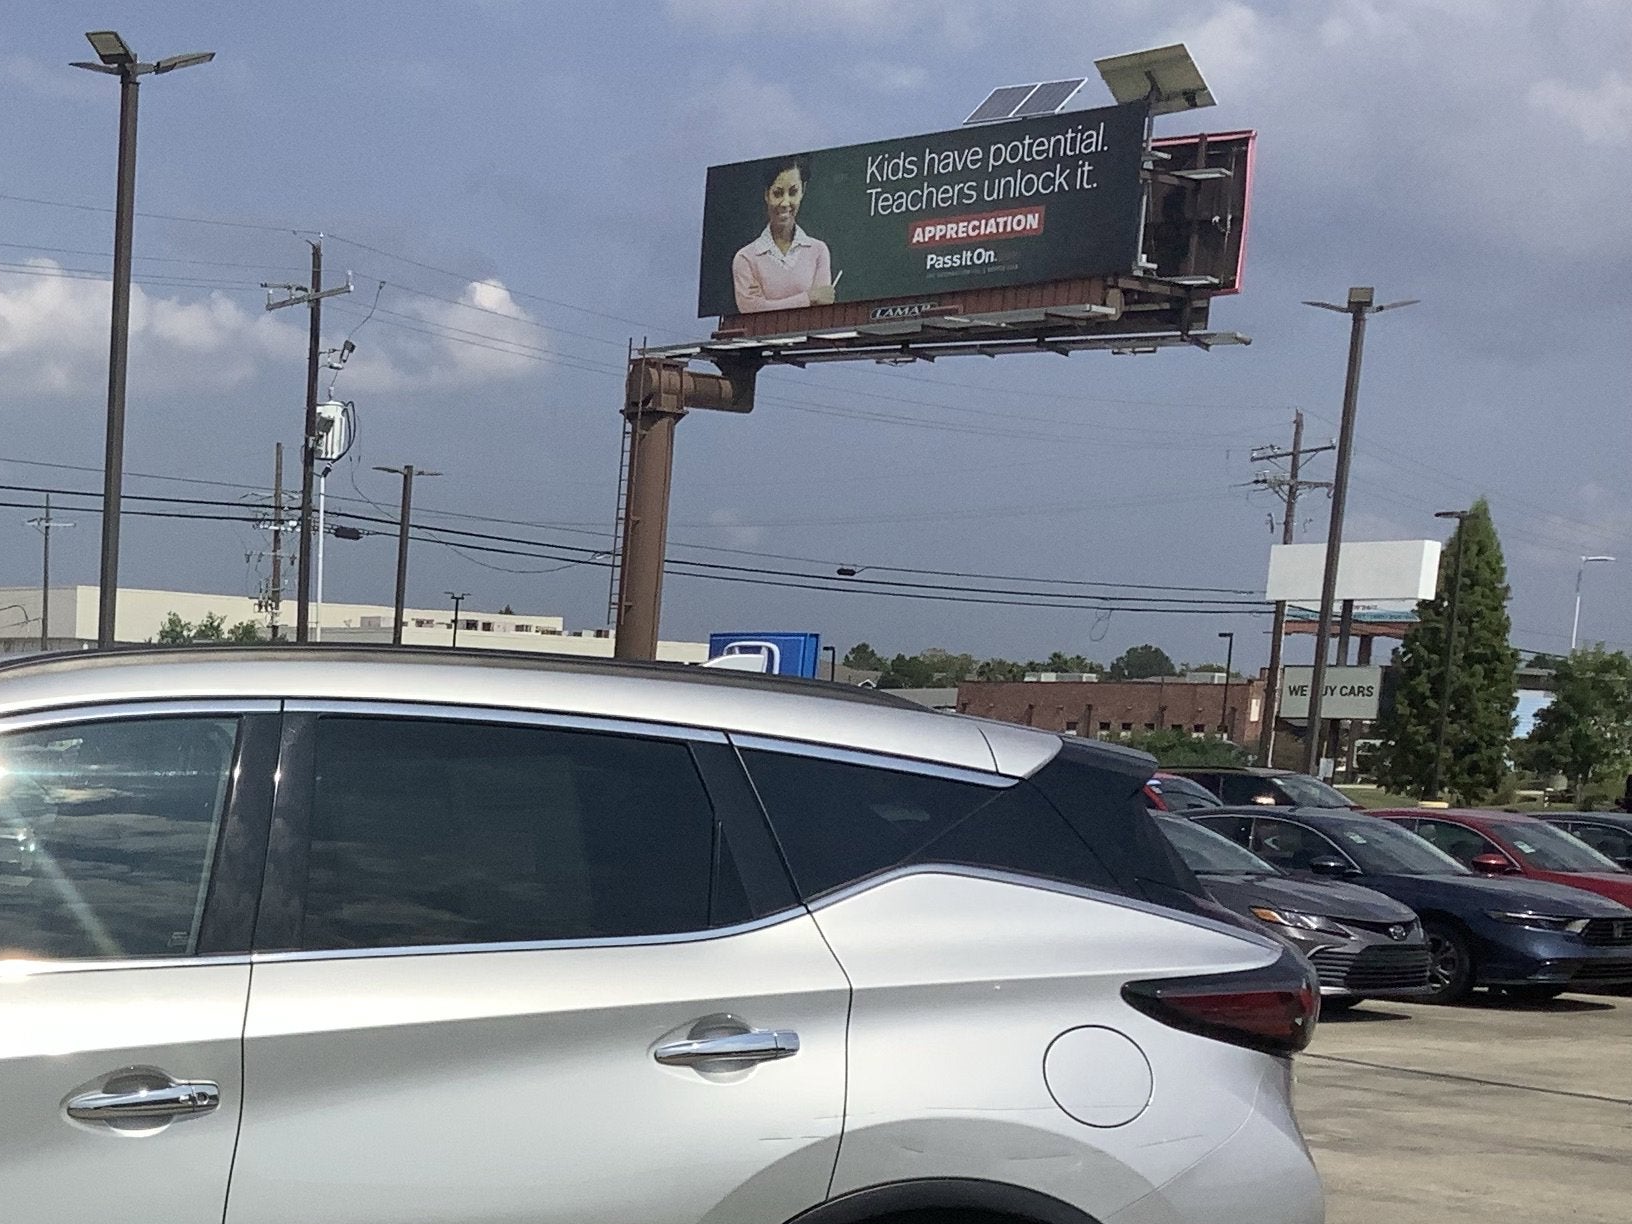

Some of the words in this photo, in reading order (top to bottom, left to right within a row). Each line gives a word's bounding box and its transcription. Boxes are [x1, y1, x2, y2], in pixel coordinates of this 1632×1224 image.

[866, 151, 918, 184] Kids
[923, 148, 983, 177] have
[988, 122, 1109, 173] potential.
[866, 181, 978, 217] Teachers
[983, 163, 1071, 201] unlock
[1075, 160, 1098, 190] it.
[911, 213, 1040, 244] APPRECIATION
[1288, 685, 1308, 697] WE
[1339, 685, 1374, 698] CARS
